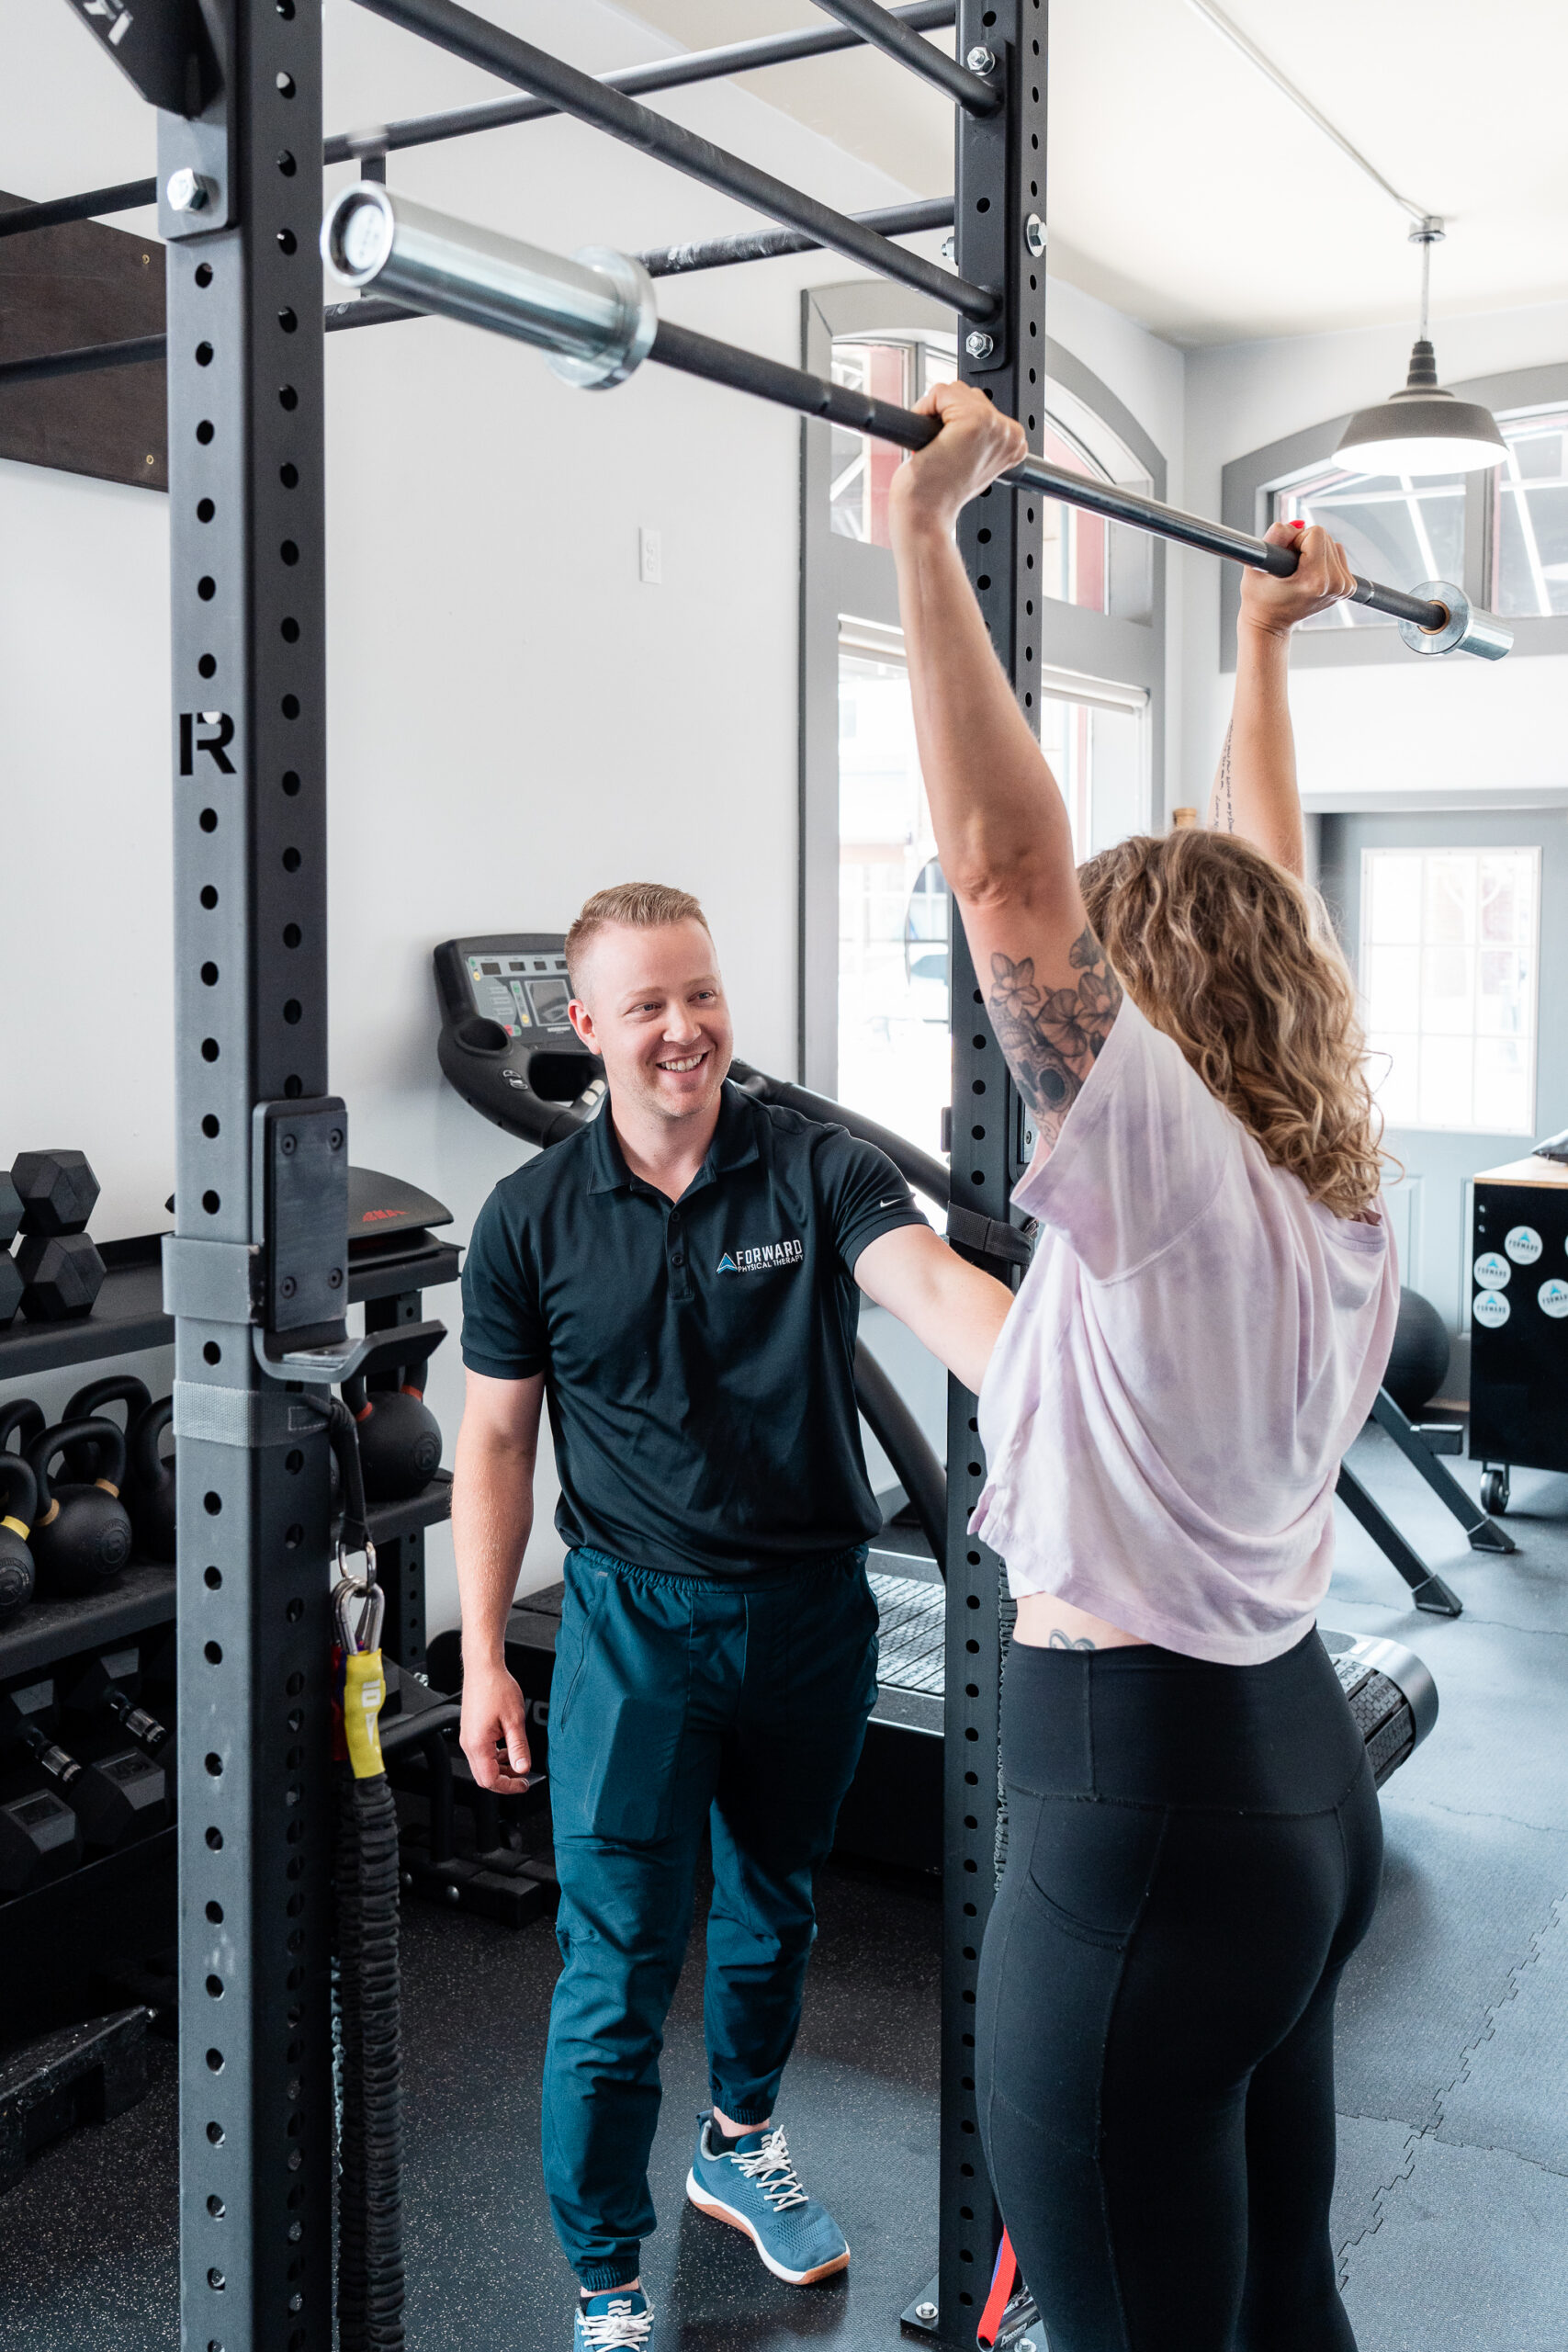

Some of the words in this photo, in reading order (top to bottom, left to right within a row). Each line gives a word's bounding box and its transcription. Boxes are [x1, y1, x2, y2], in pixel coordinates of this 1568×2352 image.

[180, 712, 237, 775] R
[736, 1239, 803, 1265] FORWARD
[738, 1261, 772, 1272] PHYSICAL
[773, 1254, 804, 1266] THERAPY
[1542, 1294, 1568, 1305] FORWAR
